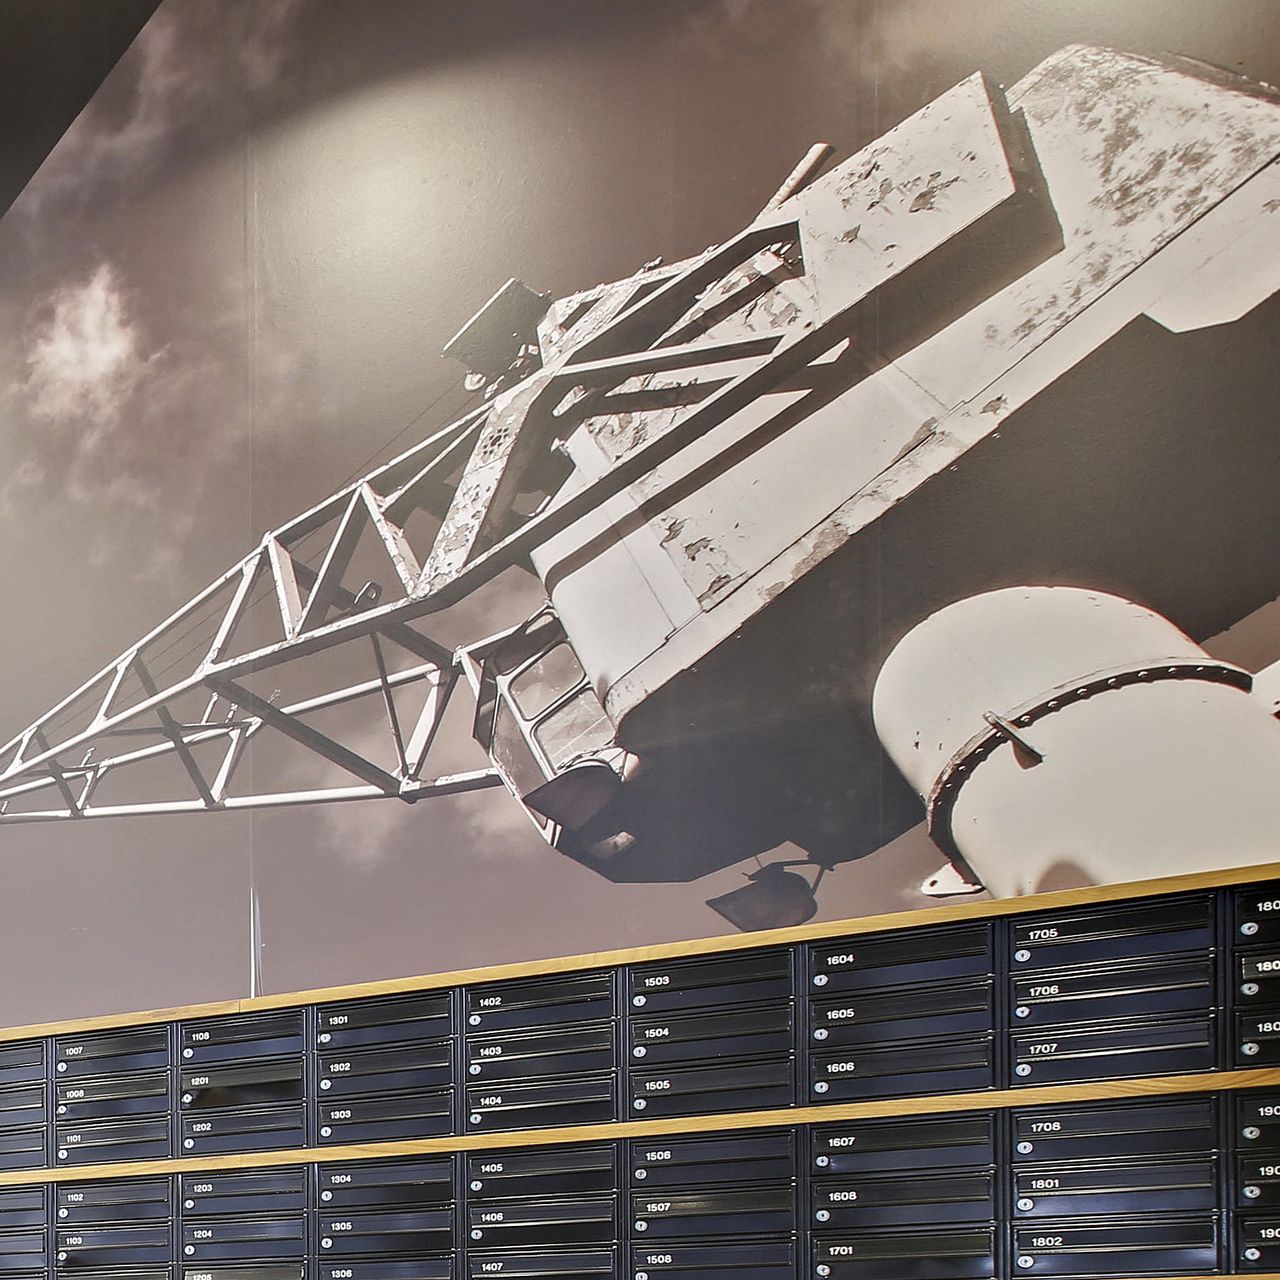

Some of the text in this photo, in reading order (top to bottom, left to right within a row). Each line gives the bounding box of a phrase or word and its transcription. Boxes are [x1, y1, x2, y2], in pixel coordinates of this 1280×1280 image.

[1028, 928, 1060, 942] 1705
[826, 954, 854, 966] 1604
[644, 975, 670, 987] 1503
[1029, 985, 1059, 997] 1706
[479, 996, 502, 1007] 1402
[826, 1008, 855, 1020] 1605
[329, 1015, 348, 1026] 1301
[644, 1027, 669, 1038] 1504
[65, 1046, 83, 1056] 1007
[479, 1046, 502, 1057] 1403
[1029, 1043, 1058, 1055] 1707
[329, 1062, 351, 1073] 1302
[826, 1062, 855, 1073] 1606
[191, 1076, 209, 1086] 1201
[645, 1080, 671, 1091] 1505
[480, 1096, 502, 1106] 1404
[330, 1109, 352, 1120] 1303
[192, 1122, 212, 1132] 1202
[1031, 1121, 1061, 1133] 1708
[66, 1134, 81, 1143] 1101
[828, 1136, 856, 1147] 1607
[645, 1150, 671, 1161] 1506
[480, 1163, 503, 1173] 1405
[331, 1174, 352, 1184] 1304
[1031, 1179, 1059, 1189] 1801
[193, 1183, 213, 1193] 1203
[67, 1193, 84, 1202] 1102
[828, 1191, 857, 1201] 1608
[646, 1202, 671, 1212] 1507
[481, 1212, 504, 1222] 1406
[331, 1221, 352, 1231] 1305
[193, 1229, 213, 1239] 1204
[65, 1236, 83, 1245] 1103
[1031, 1236, 1063, 1247] 1802
[828, 1246, 853, 1256] 1701
[646, 1254, 672, 1264] 1508
[481, 1262, 504, 1272] 1407
[331, 1269, 353, 1279] 1306
